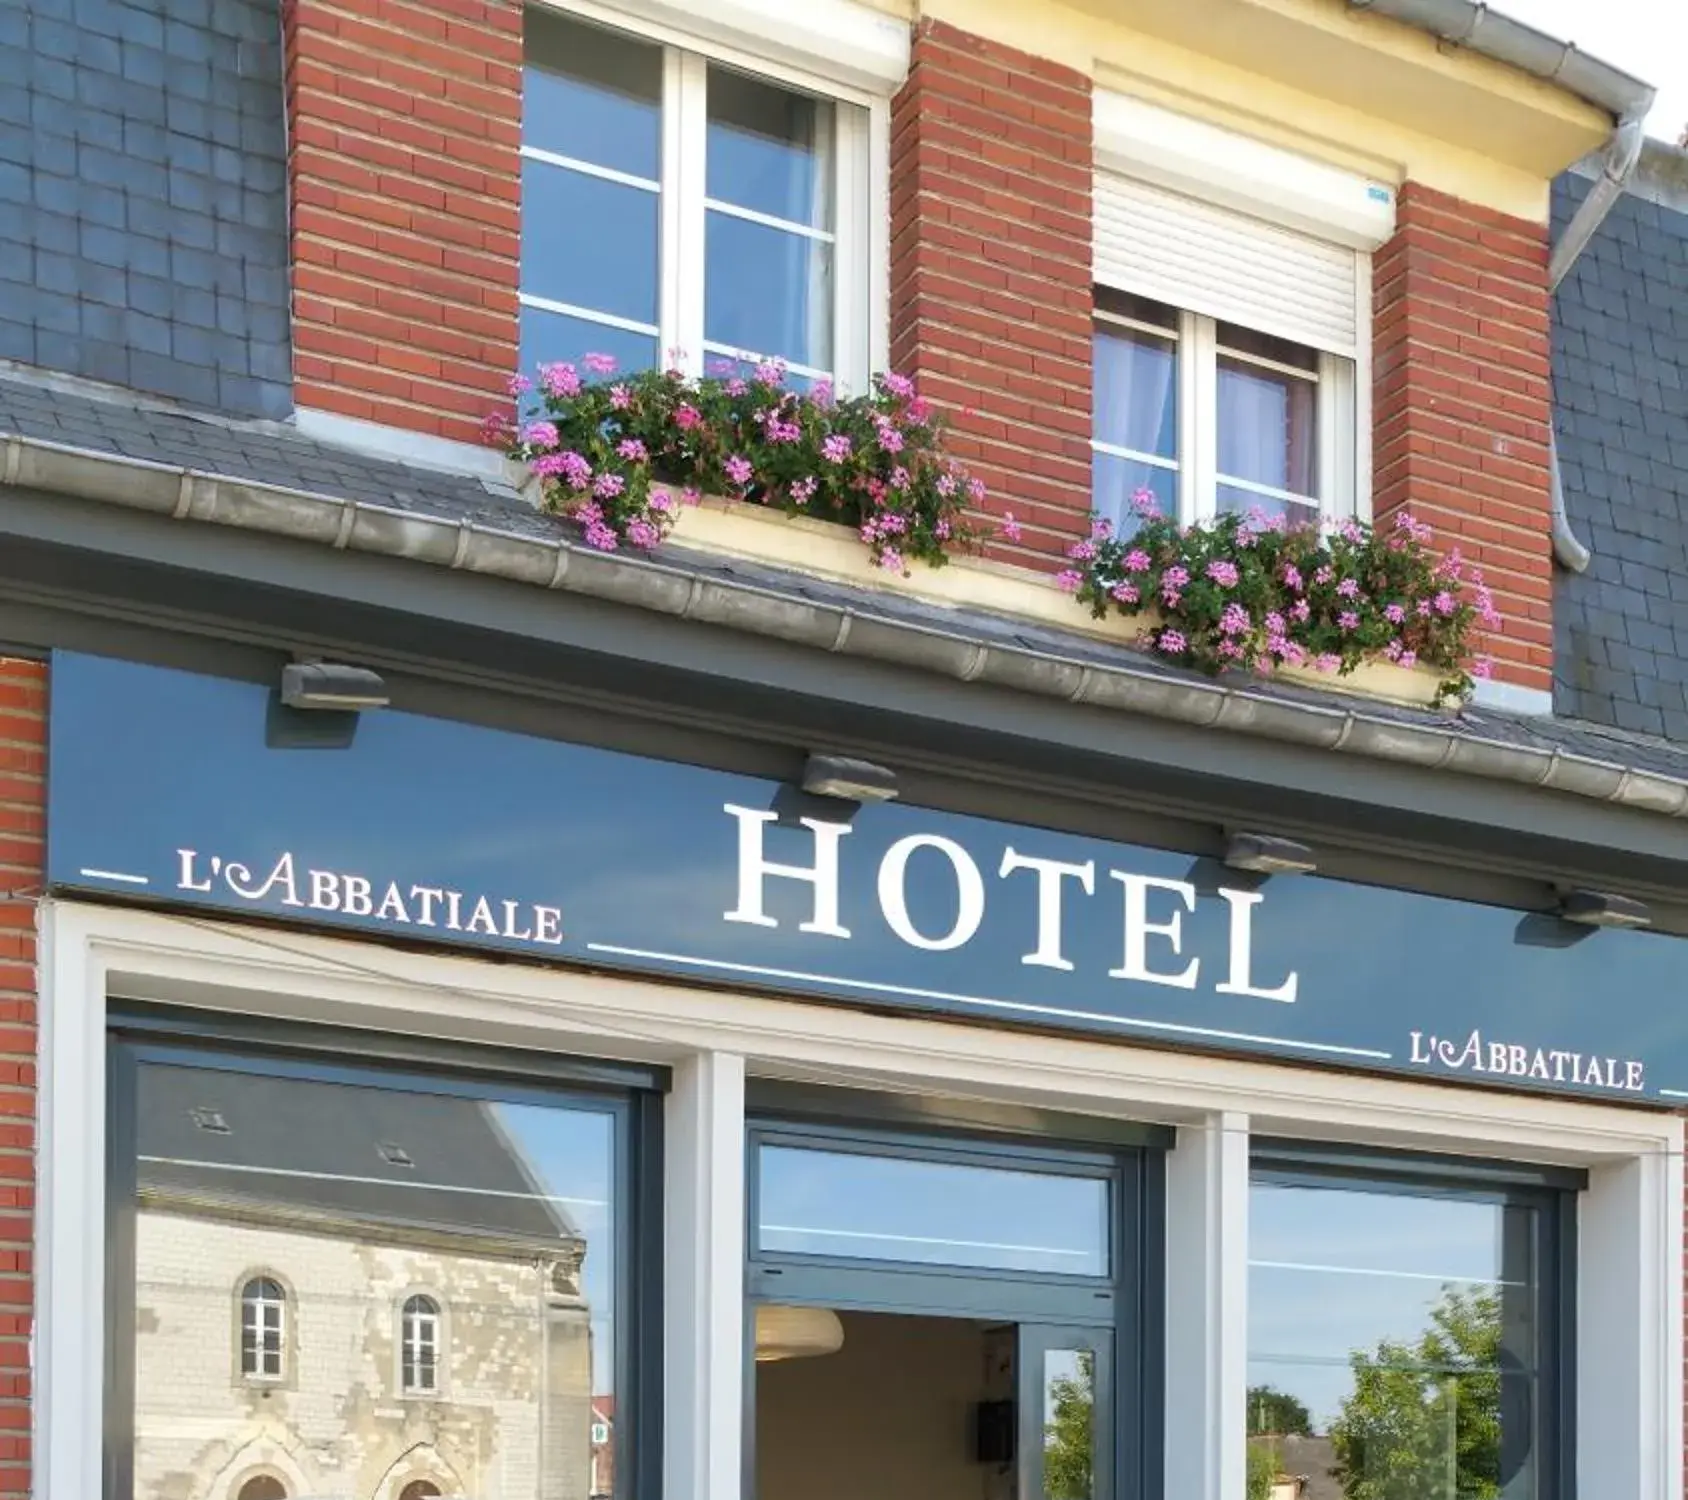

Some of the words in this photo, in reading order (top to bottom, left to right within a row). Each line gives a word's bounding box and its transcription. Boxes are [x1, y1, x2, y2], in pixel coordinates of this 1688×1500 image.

[176, 848, 564, 946] L'ABBATIALE
[722, 802, 1299, 1004] HOTEL
[1409, 1028, 1646, 1092] L'ABBATIALE
